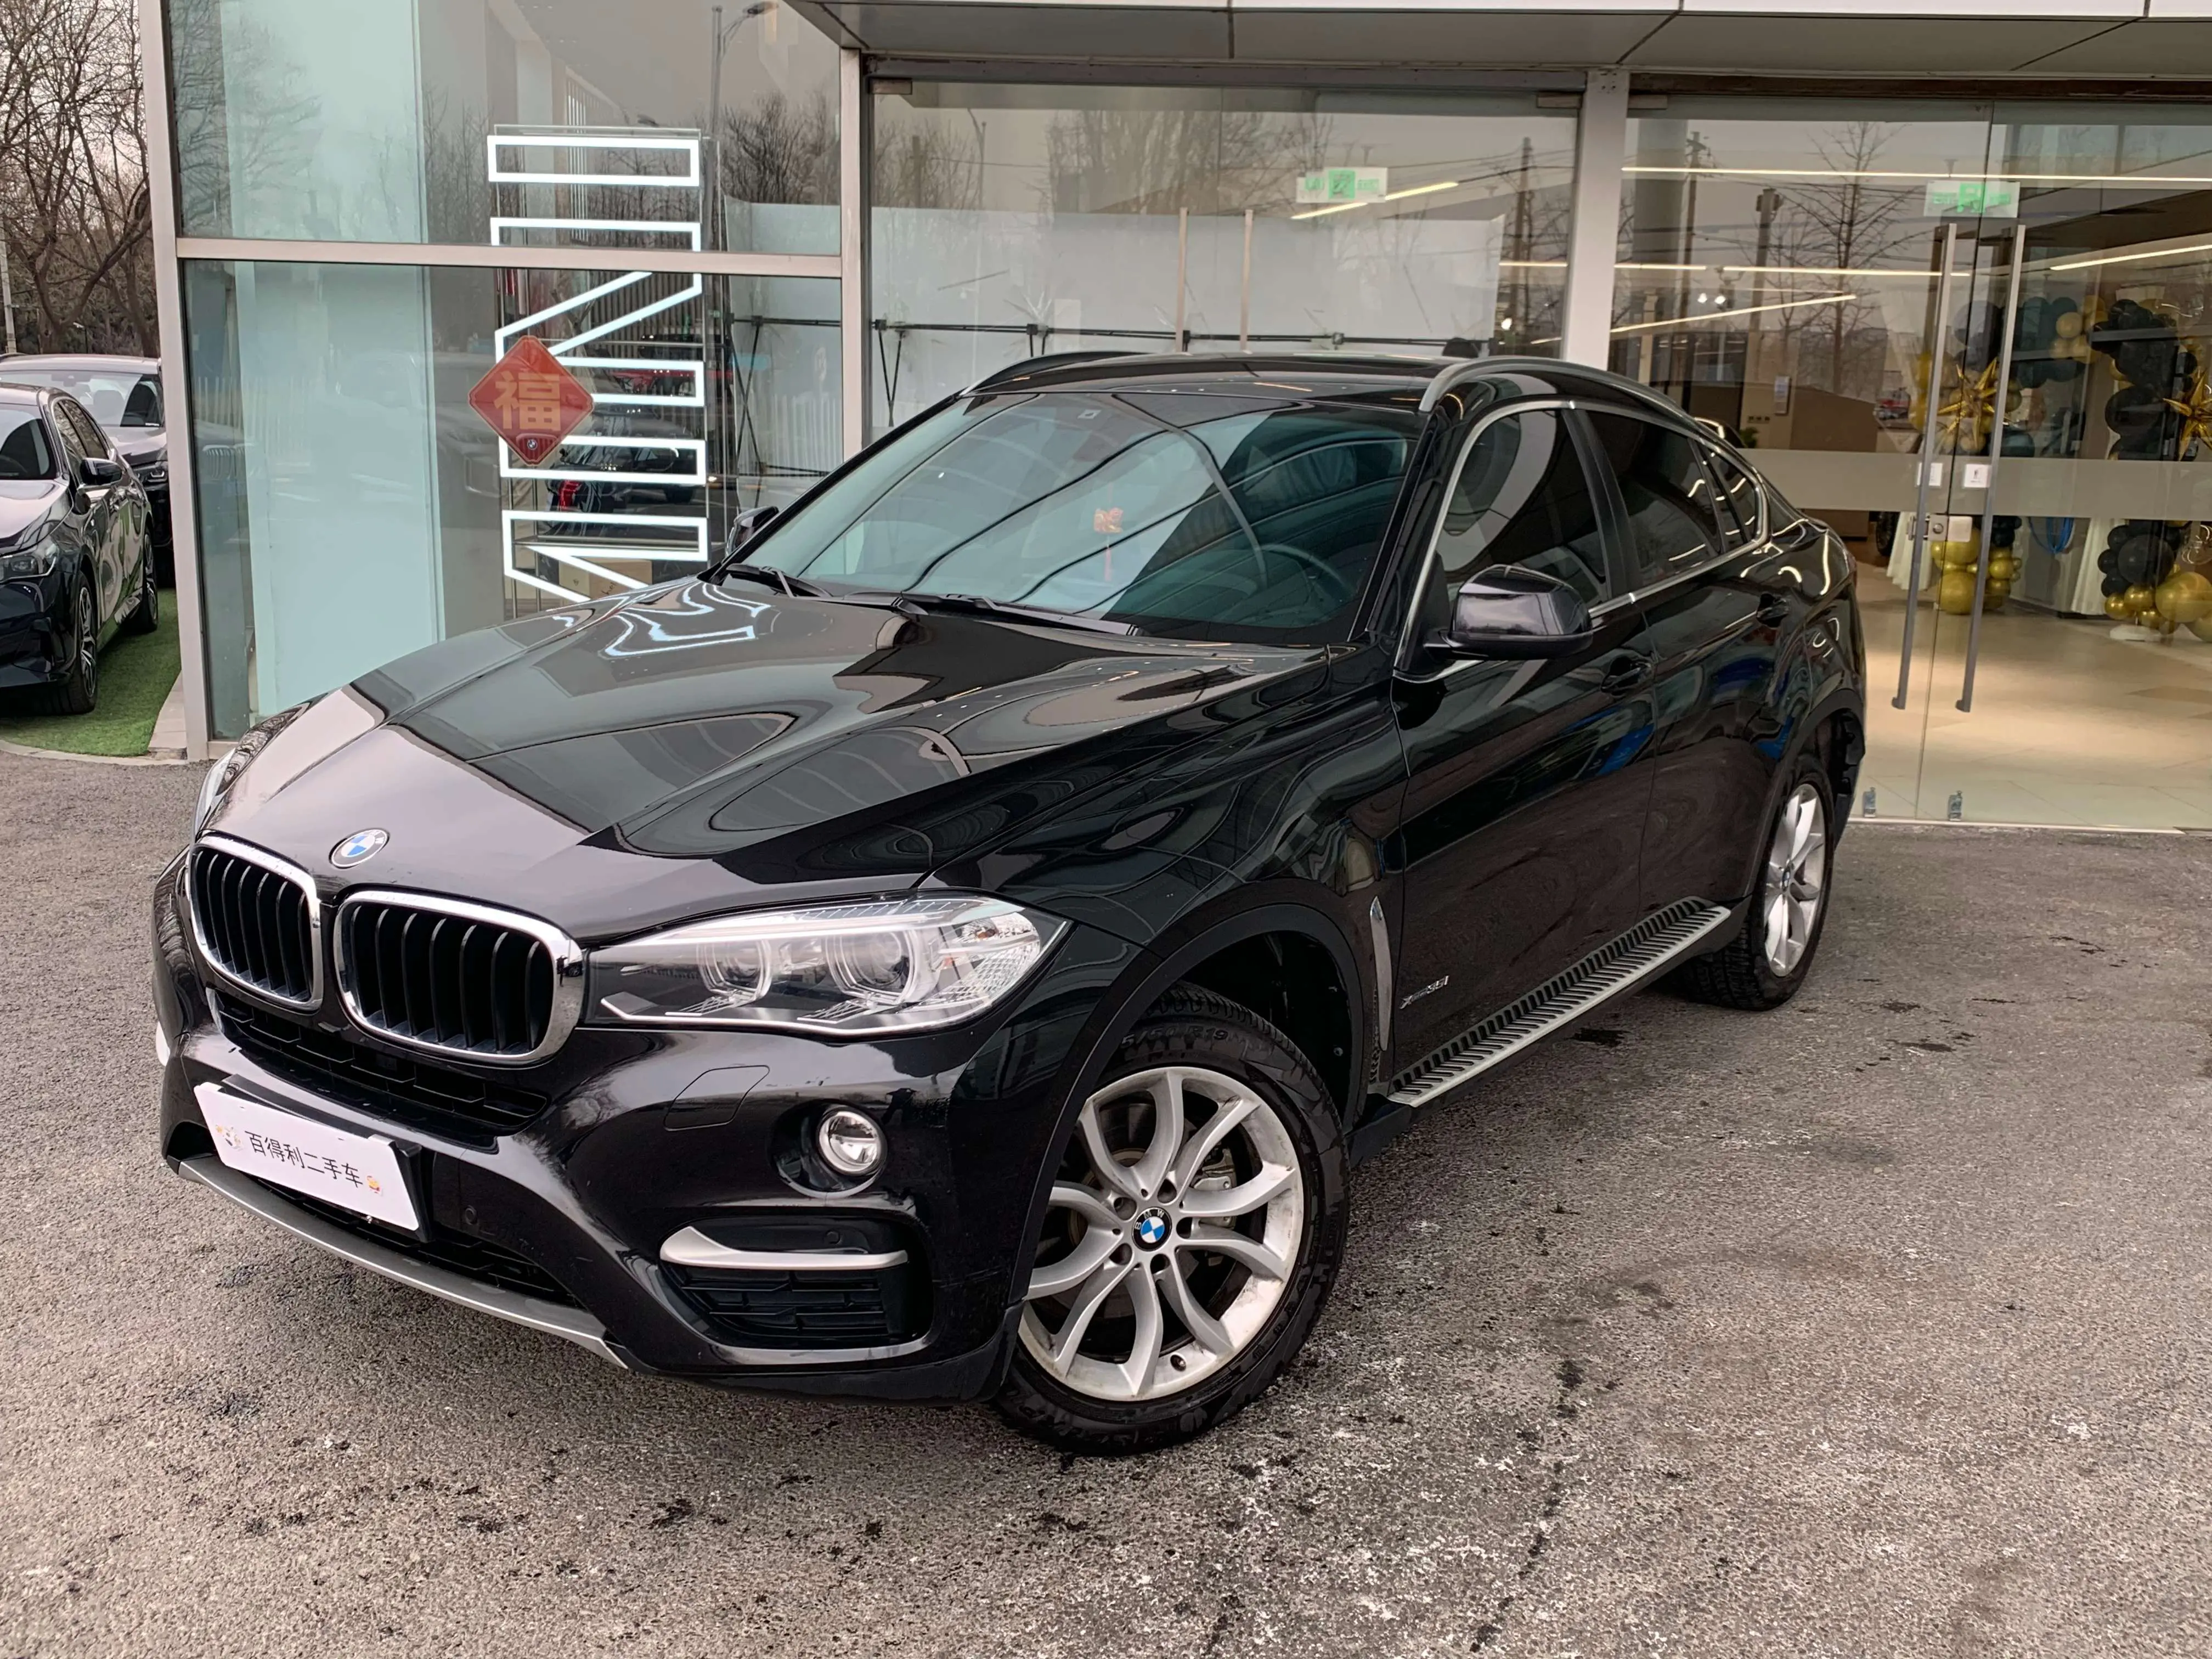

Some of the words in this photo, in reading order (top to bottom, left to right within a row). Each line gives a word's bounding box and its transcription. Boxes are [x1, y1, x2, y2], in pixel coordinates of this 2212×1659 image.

[494, 371, 561, 431] 福
[245, 1130, 363, 1188] 百得利二手车
